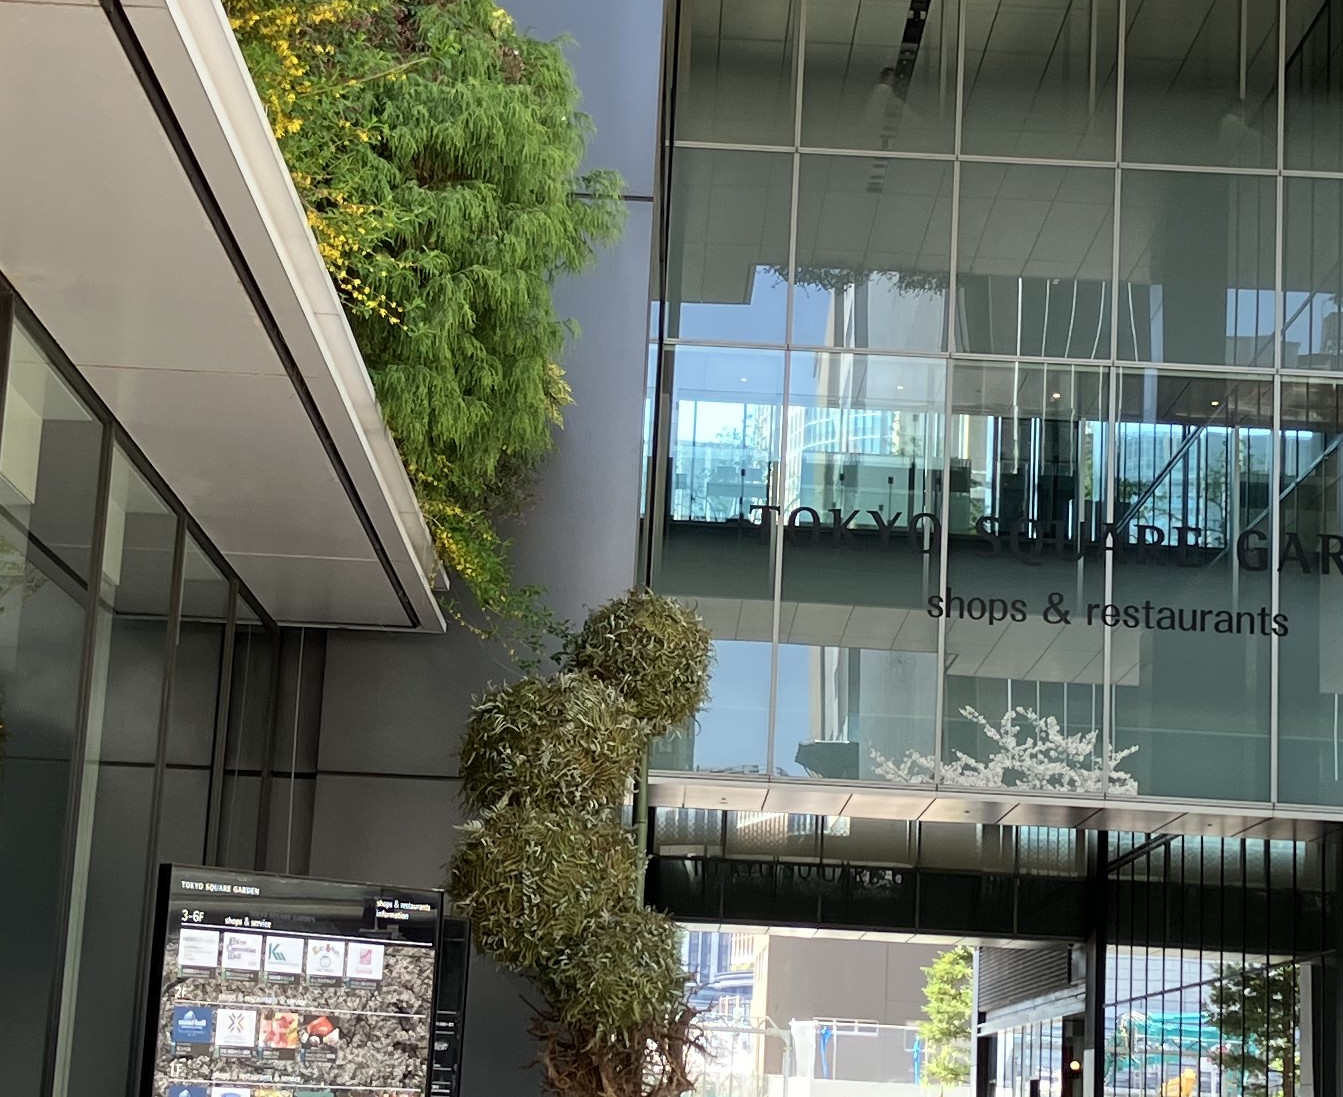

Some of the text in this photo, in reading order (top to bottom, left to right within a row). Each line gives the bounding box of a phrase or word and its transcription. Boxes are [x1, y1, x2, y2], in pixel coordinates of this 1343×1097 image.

[749, 505, 942, 554] TOKYO
[975, 515, 1204, 568] SQUARE
[926, 587, 1290, 638] shops & restaurants
[181, 880, 261, 896] TOKYO SQUARE GARDEN
[181, 908, 205, 922] 3-6F
[224, 915, 243, 926] shops
[251, 918, 272, 928] service
